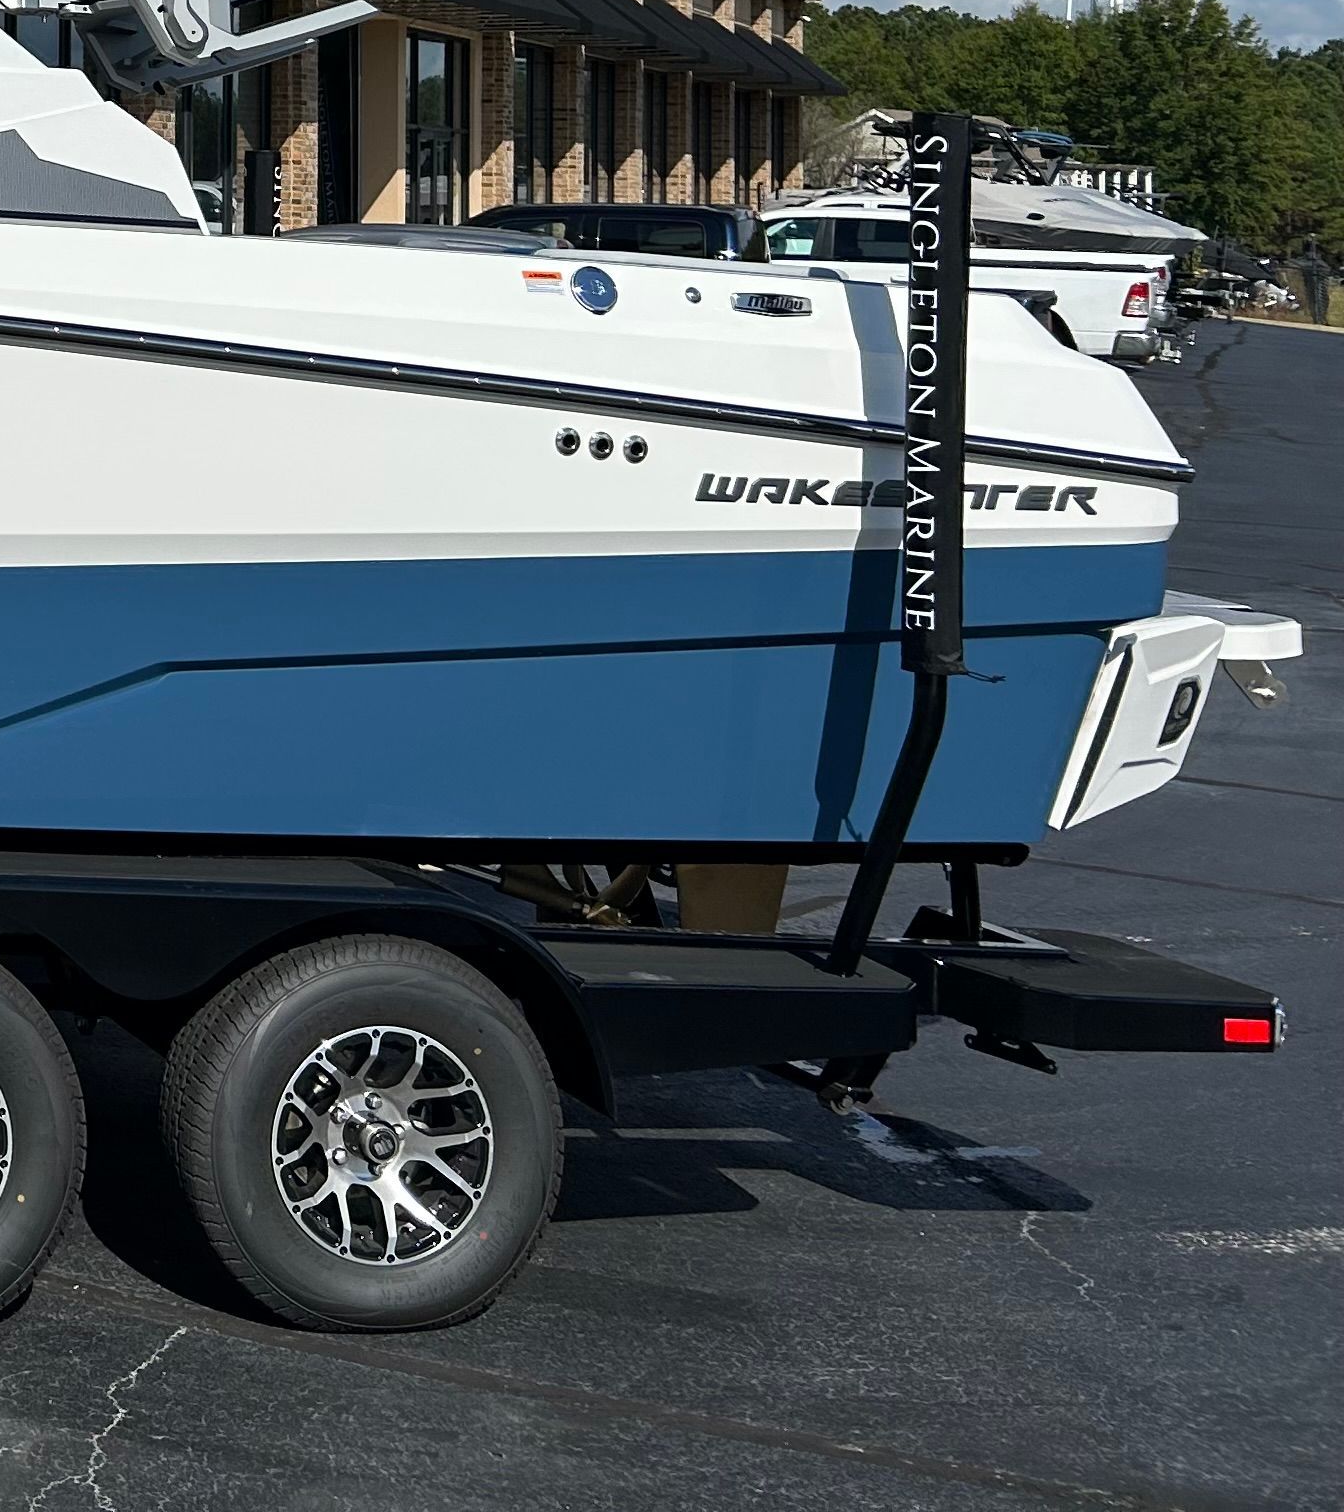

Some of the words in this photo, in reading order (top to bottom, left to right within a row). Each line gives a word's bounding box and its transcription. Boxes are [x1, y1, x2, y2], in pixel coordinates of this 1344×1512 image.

[908, 134, 948, 418] SINGLETON
[694, 472, 1098, 516] WAKESTTER
[905, 435, 941, 631] MARINE
